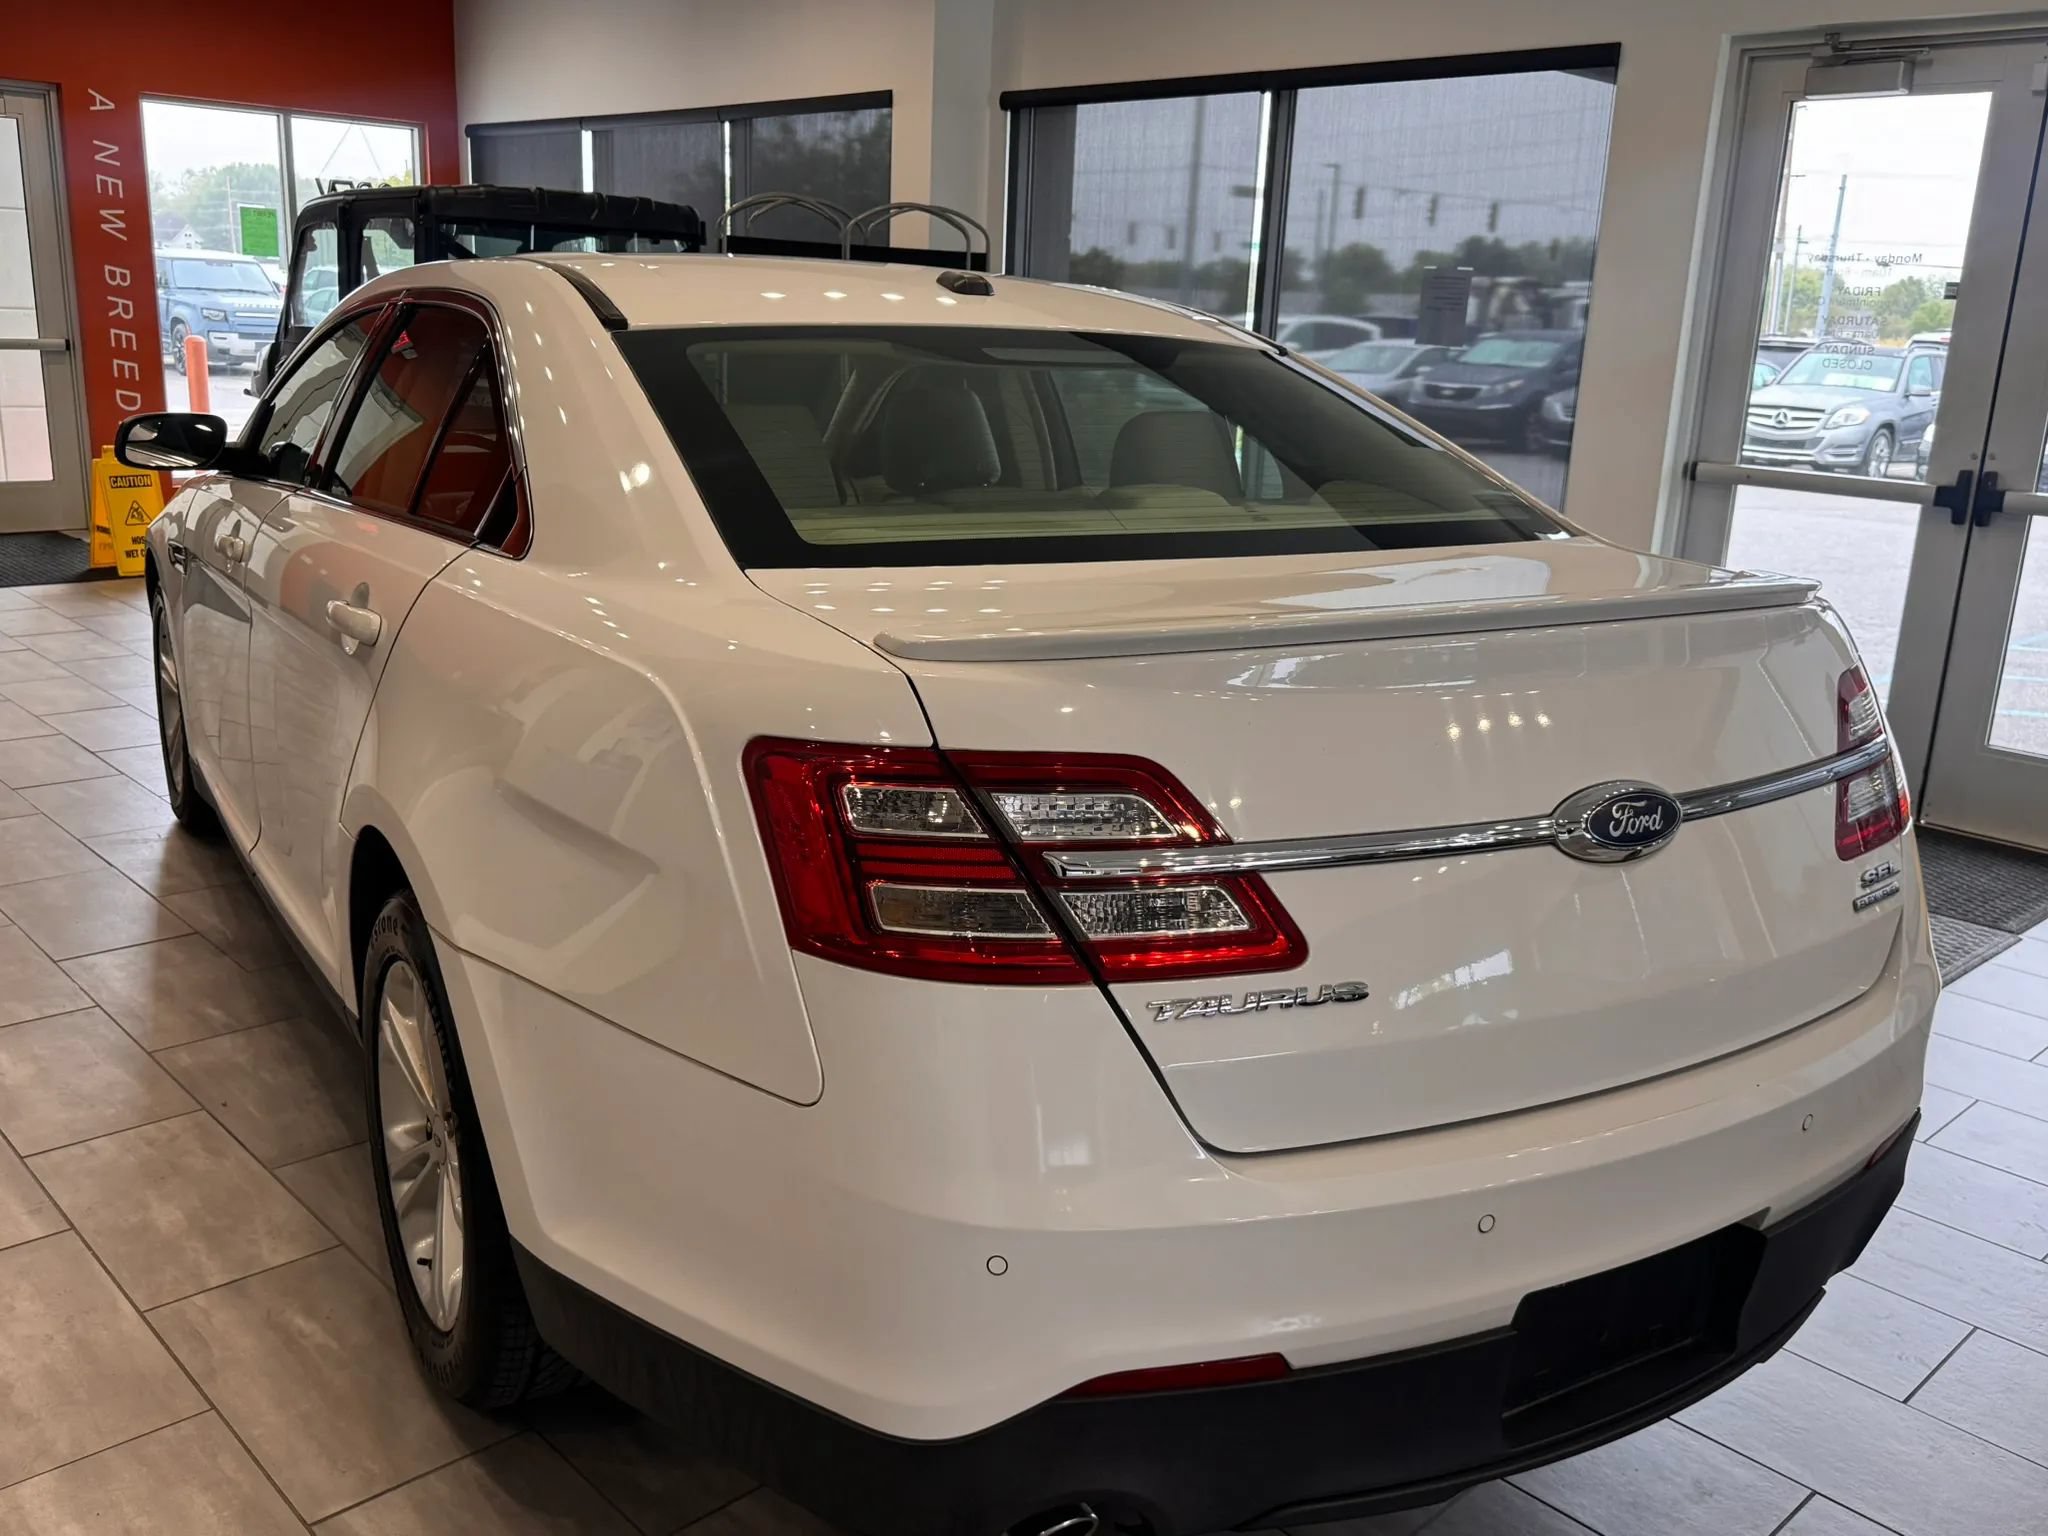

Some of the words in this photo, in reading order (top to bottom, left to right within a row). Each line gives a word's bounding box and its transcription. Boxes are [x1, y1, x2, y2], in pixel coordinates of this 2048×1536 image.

[87, 88, 116, 111] A
[92, 140, 128, 241] NEW
[110, 475, 152, 489] CAUTION
[1608, 800, 1664, 838] Ford
[1146, 981, 1370, 1022] TAURUS
